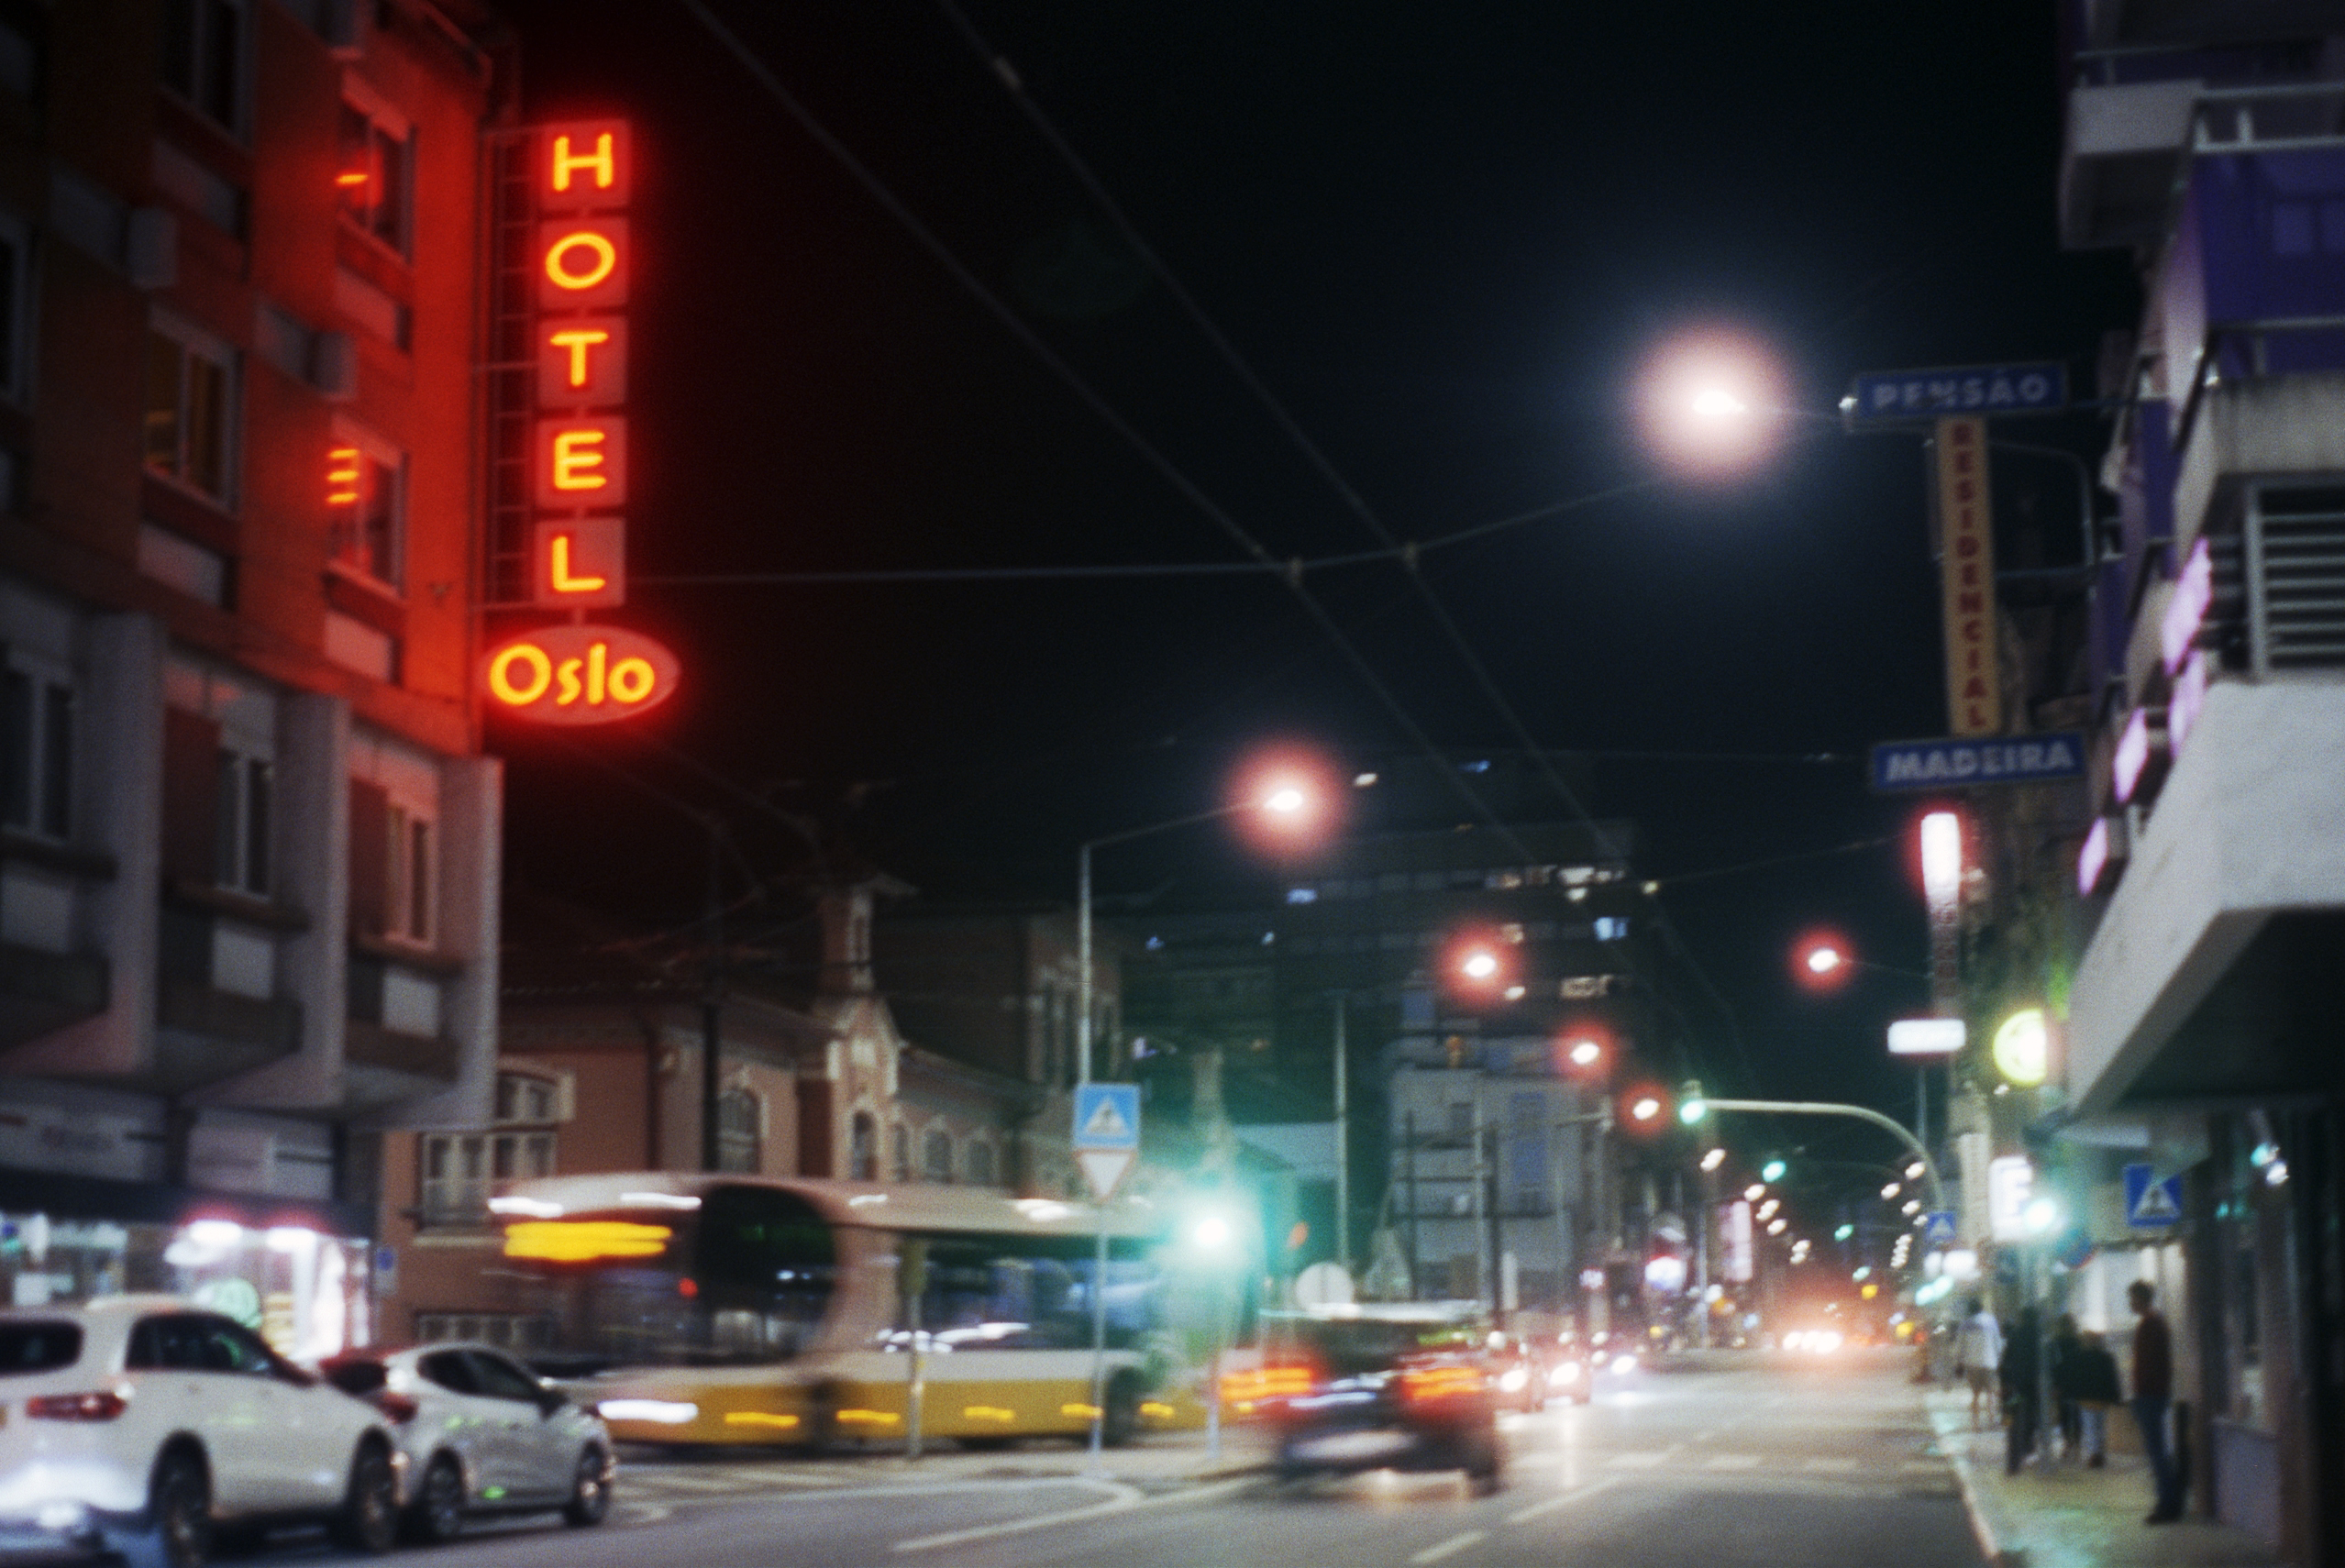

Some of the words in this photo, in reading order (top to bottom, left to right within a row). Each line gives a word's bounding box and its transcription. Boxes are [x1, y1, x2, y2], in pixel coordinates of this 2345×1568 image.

[546, 132, 615, 592] HOTEL
[1952, 422, 1988, 729] RESIDENCIAL
[489, 643, 655, 705] Oslo
[1885, 741, 2074, 783] MADEIRA
